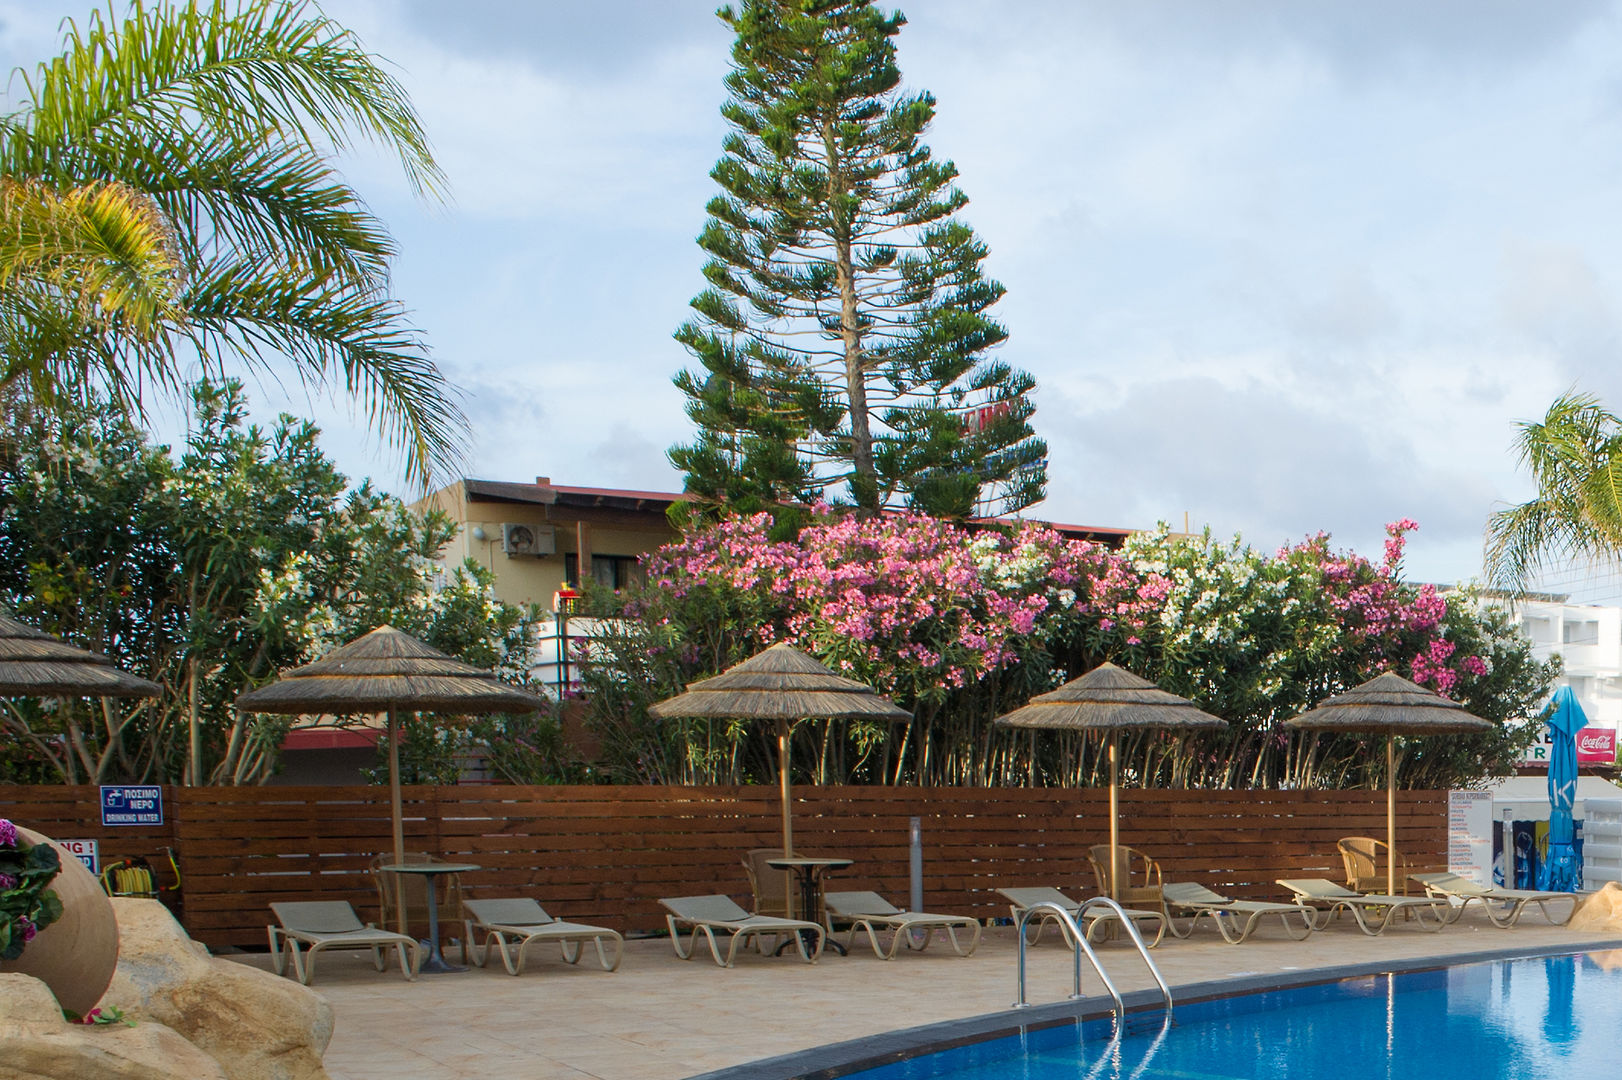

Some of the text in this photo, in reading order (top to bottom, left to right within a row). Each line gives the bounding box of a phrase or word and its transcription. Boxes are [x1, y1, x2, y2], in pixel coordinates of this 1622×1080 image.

[1581, 735, 1612, 750] Coca-Cola
[124, 789, 158, 799] ΠΟΣΙΜΟ
[106, 813, 159, 822] DRINKING WATER
